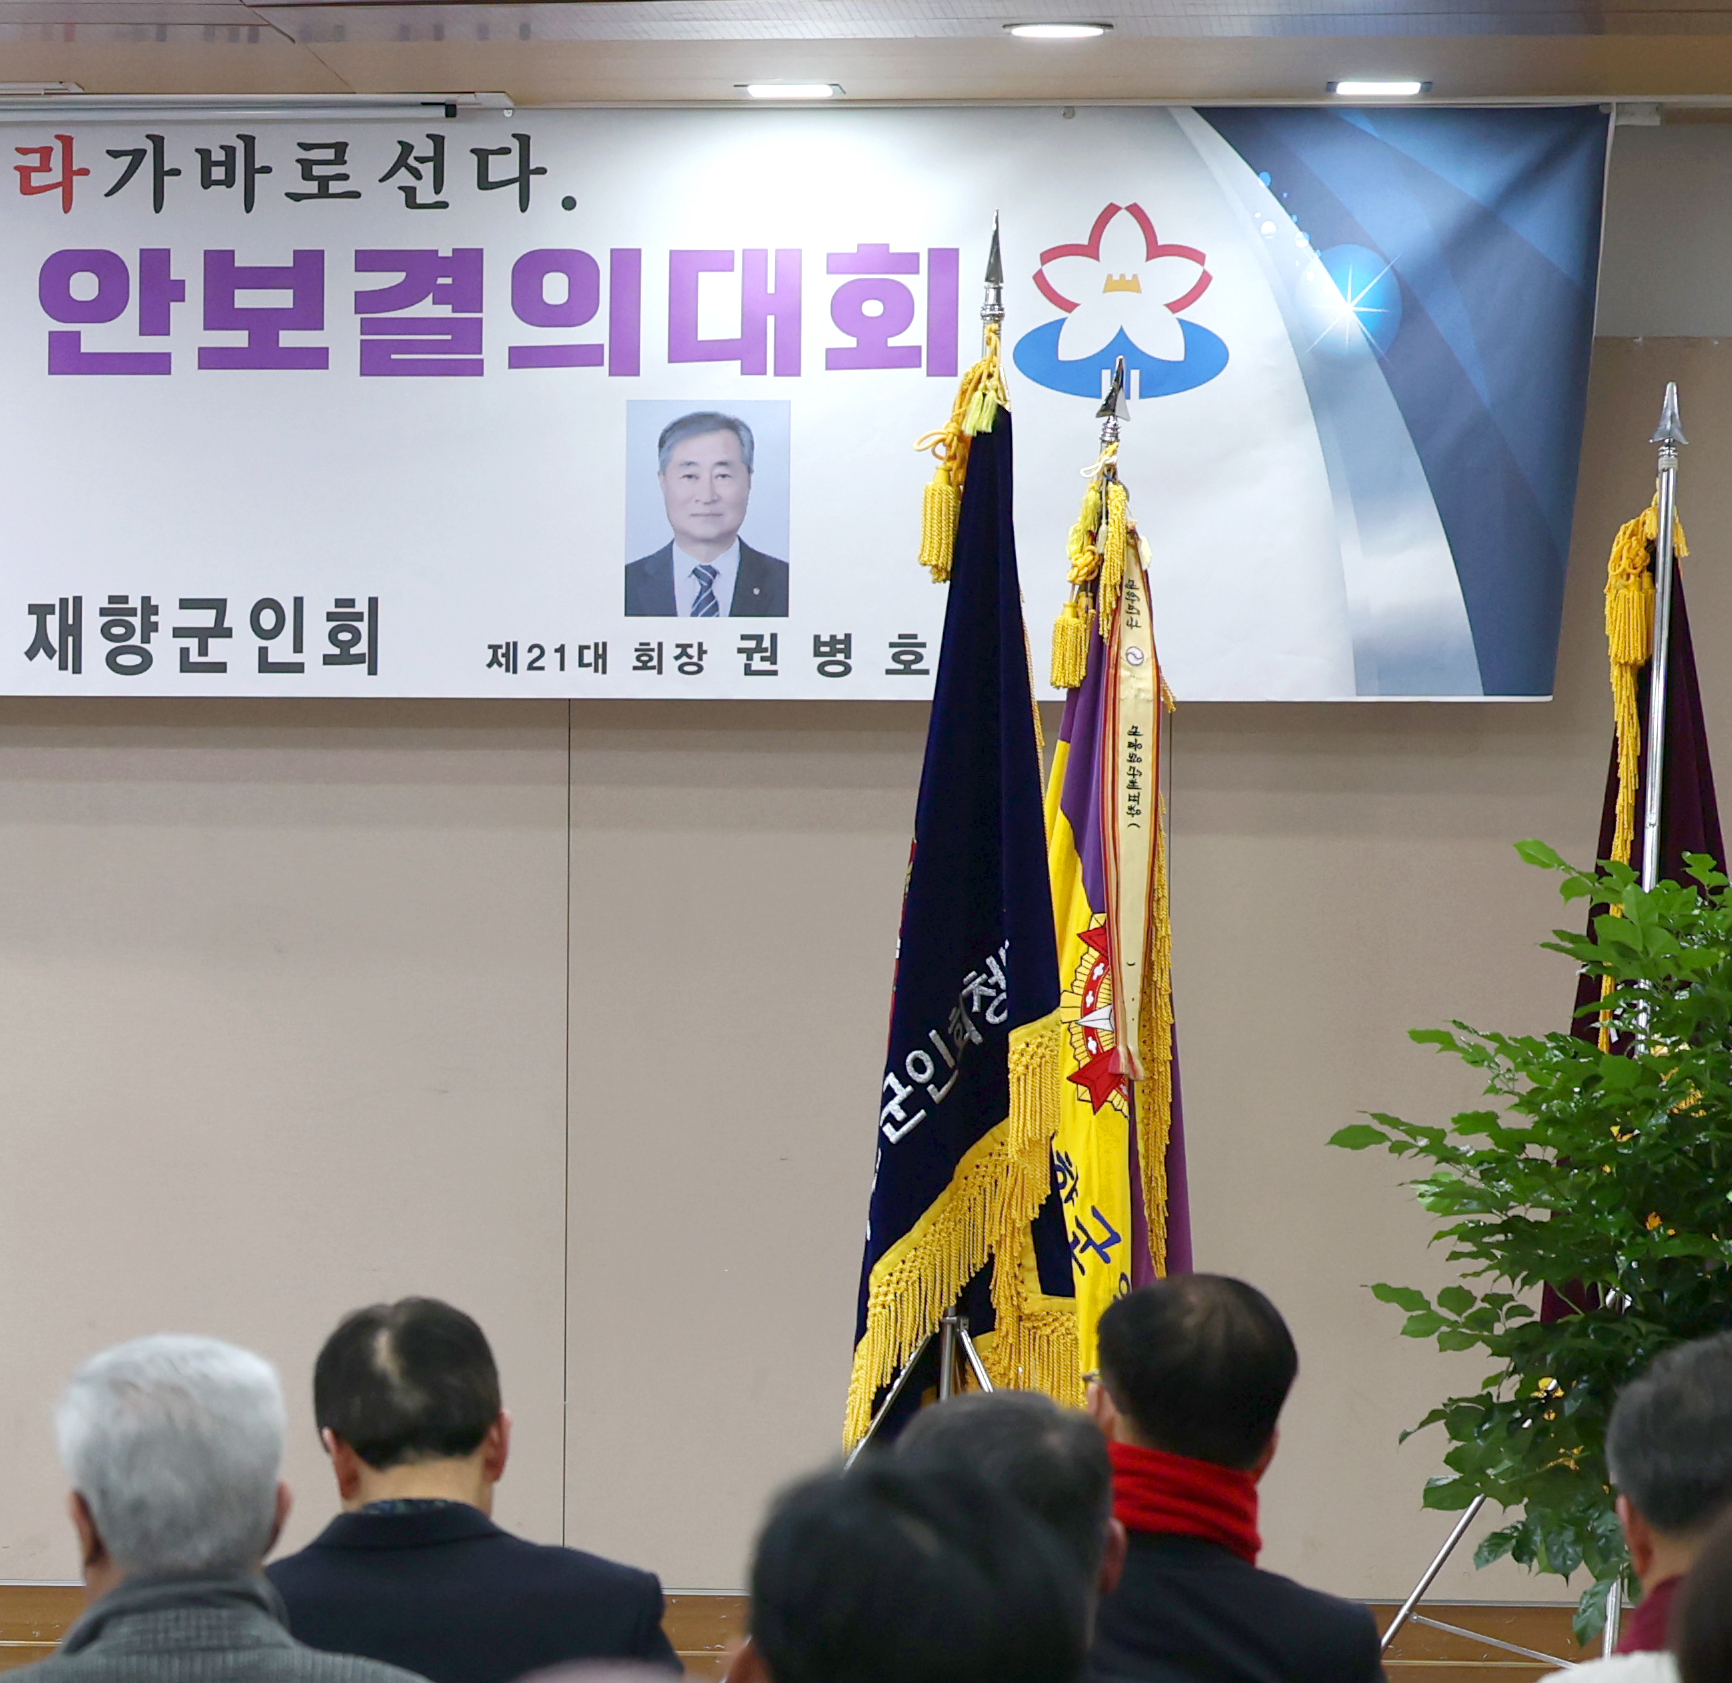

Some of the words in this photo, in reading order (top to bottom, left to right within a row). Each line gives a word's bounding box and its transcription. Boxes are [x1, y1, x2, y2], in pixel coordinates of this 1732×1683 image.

[38, 243, 960, 377] 안보결의대회
[23, 593, 379, 677] 재향군인회
[485, 640, 608, 676] 제21대
[631, 641, 709, 676] 회장
